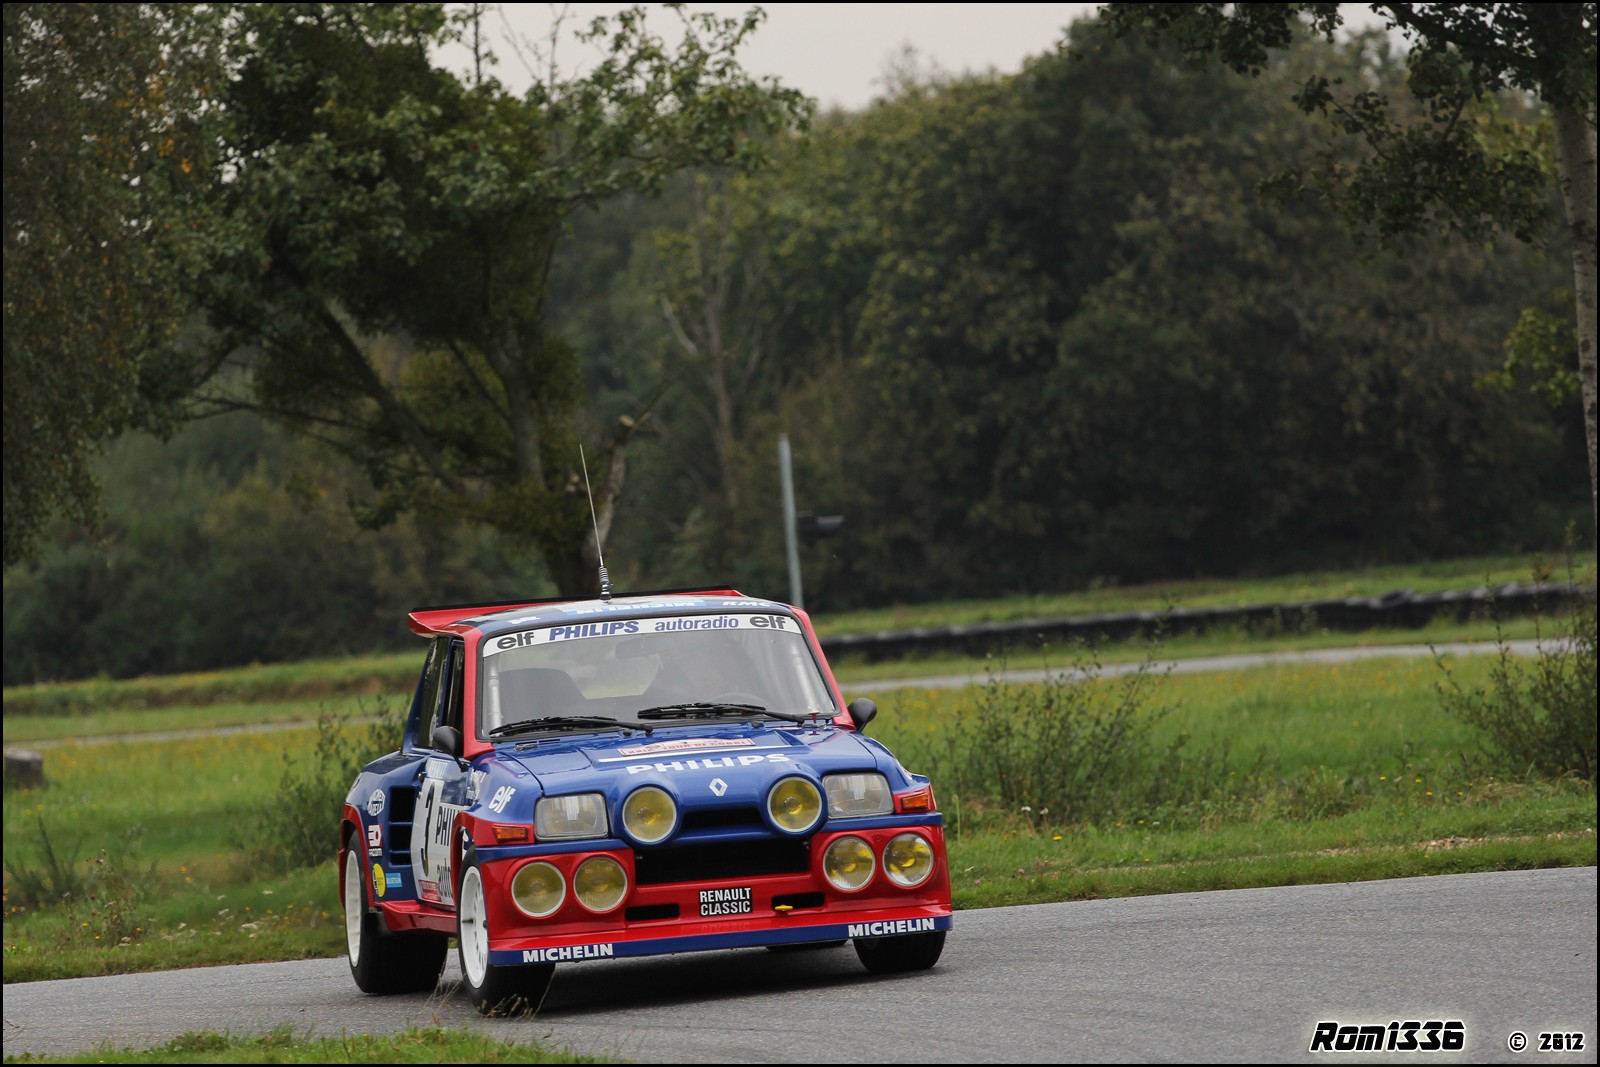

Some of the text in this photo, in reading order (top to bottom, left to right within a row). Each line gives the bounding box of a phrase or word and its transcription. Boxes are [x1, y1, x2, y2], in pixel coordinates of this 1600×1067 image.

[497, 632, 534, 649] elf
[549, 620, 639, 641] PHILIPS
[654, 615, 739, 632] autoradio
[749, 615, 786, 630] elf
[625, 753, 790, 775] PHILIPS
[488, 785, 516, 814] elf
[700, 887, 751, 903] RENAULT
[700, 900, 751, 916] CLASSIC
[848, 917, 935, 938] MICHELIN
[522, 943, 614, 964] MICHELIN
